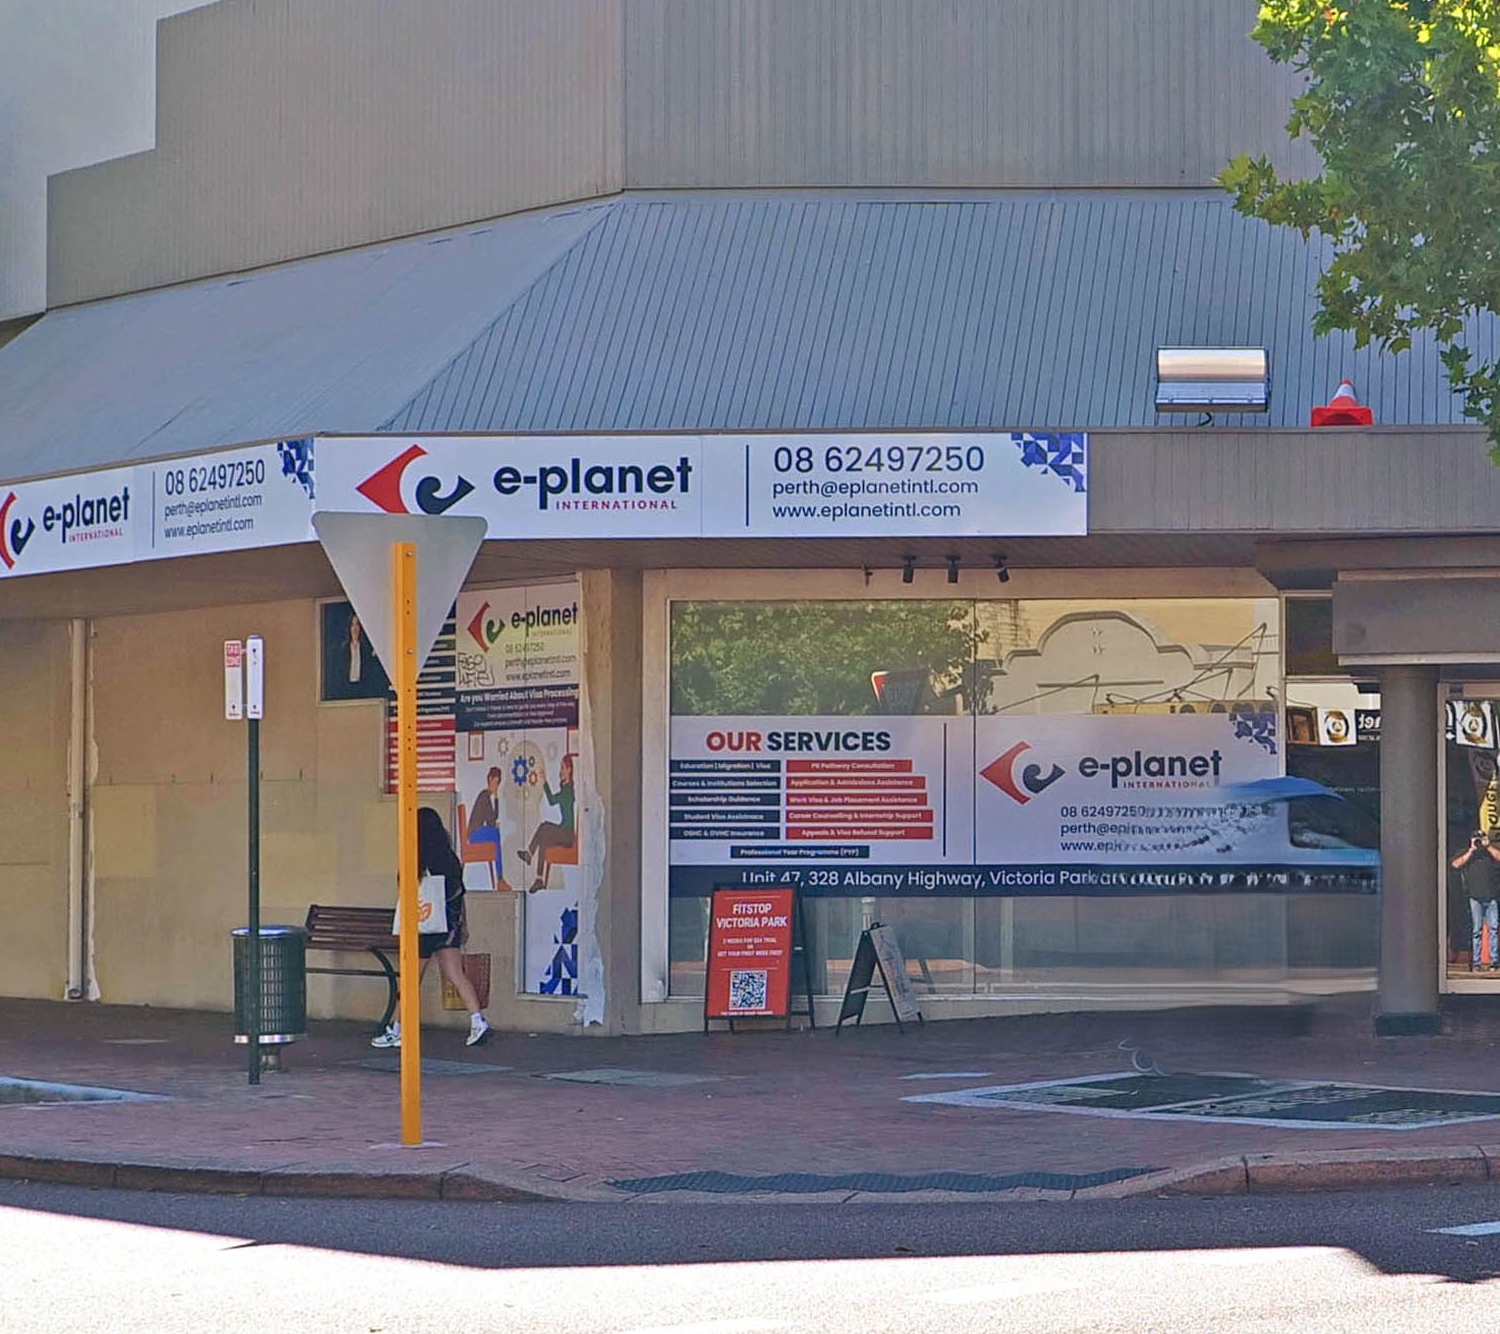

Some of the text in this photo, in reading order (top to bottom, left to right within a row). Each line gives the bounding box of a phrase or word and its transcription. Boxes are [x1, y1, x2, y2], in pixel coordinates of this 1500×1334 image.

[773, 446, 985, 473] 08 62497250
[165, 459, 265, 495] 08 62497250
[493, 457, 692, 510] e-planet
[772, 478, 979, 500] perth@eplanetintl.com
[43, 487, 130, 543] e-planet
[164, 493, 262, 522] perth@eplanetintl.com
[555, 500, 678, 510] INTERNATIONAL
[772, 501, 961, 521] www.eplanetintl.com
[69, 528, 123, 543] INTERNATIONAL
[164, 517, 254, 539] www.eplanetintl.com
[511, 602, 578, 638] e-planet
[706, 731, 891, 752] OUR SERVICES
[1078, 750, 1222, 788] e-planet
[1061, 805, 1078, 818] 08
[808, 871, 839, 886] 328
[843, 870, 902, 889] Albany
[908, 870, 986, 889] Highway,
[990, 870, 1056, 885] Victoria
[732, 903, 772, 915] FITSTOP
[716, 916, 788, 929] VICTORIA PARK
